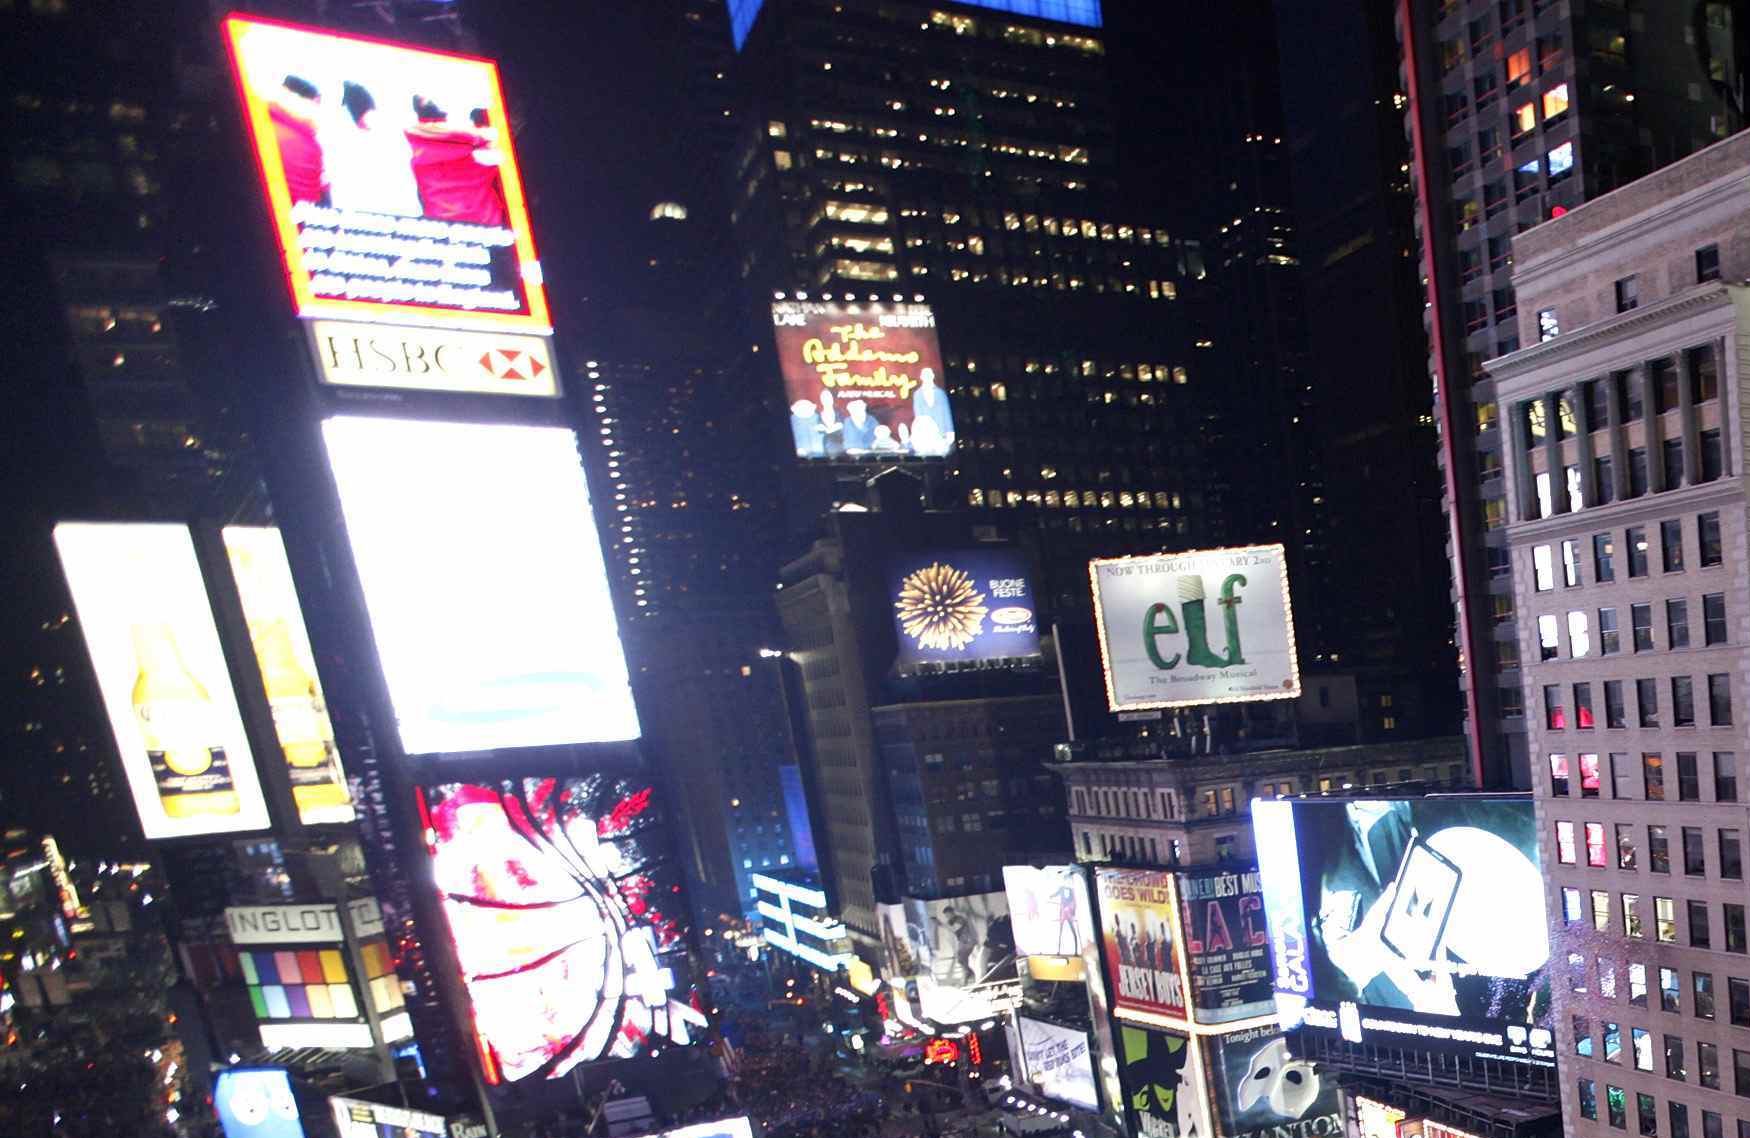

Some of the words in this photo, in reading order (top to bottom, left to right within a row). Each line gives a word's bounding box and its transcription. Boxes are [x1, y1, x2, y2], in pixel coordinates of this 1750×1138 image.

[830, 323, 886, 343] The
[327, 336, 448, 374] HSBC
[802, 338, 920, 364] Addams
[815, 362, 918, 400] Family
[1106, 564, 1136, 577] NOW
[1142, 573, 1248, 671] elf
[1169, 669, 1217, 684] Broadway
[1219, 668, 1258, 680] Musical
[1215, 874, 1239, 898] BEST
[229, 909, 337, 933] INGLOT
[1223, 1029, 1259, 1044] Tonight
